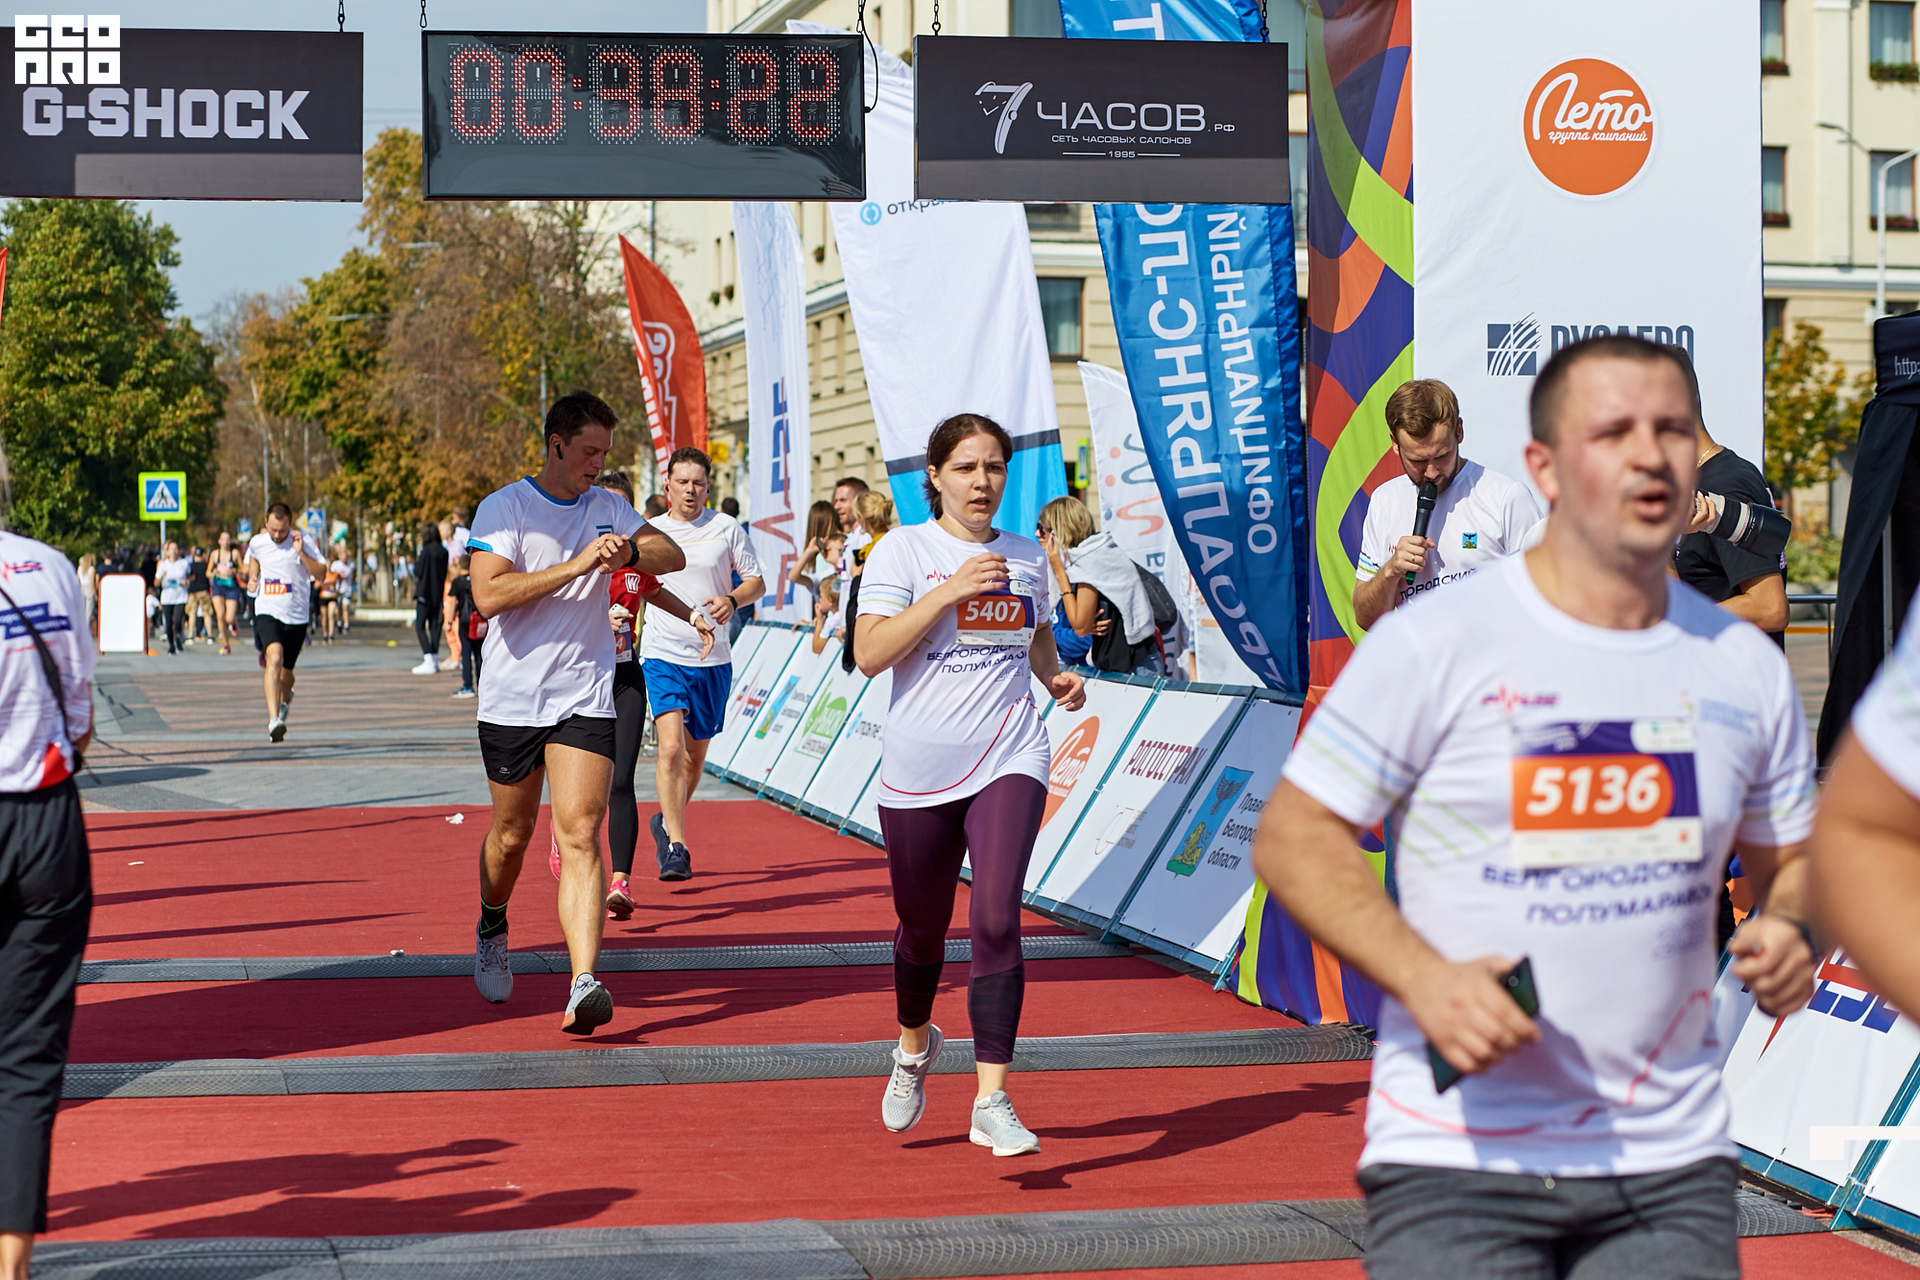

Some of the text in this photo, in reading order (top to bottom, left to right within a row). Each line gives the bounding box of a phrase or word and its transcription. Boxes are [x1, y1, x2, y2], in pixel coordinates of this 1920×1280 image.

[22, 86, 310, 140] G-SHOCK
[452, 50, 838, 137] 00:38:22
[1532, 72, 1653, 141] Лето
[1051, 135, 1192, 145] СЕТЬ ЧАСОВЫХ САЛОНОВ
[1108, 150, 1136, 159] 1995
[1548, 131, 1590, 145] группа
[964, 600, 1022, 622] 5407
[1122, 739, 1209, 785] РОСГОССТРАХ
[1525, 762, 1661, 817] 5136
